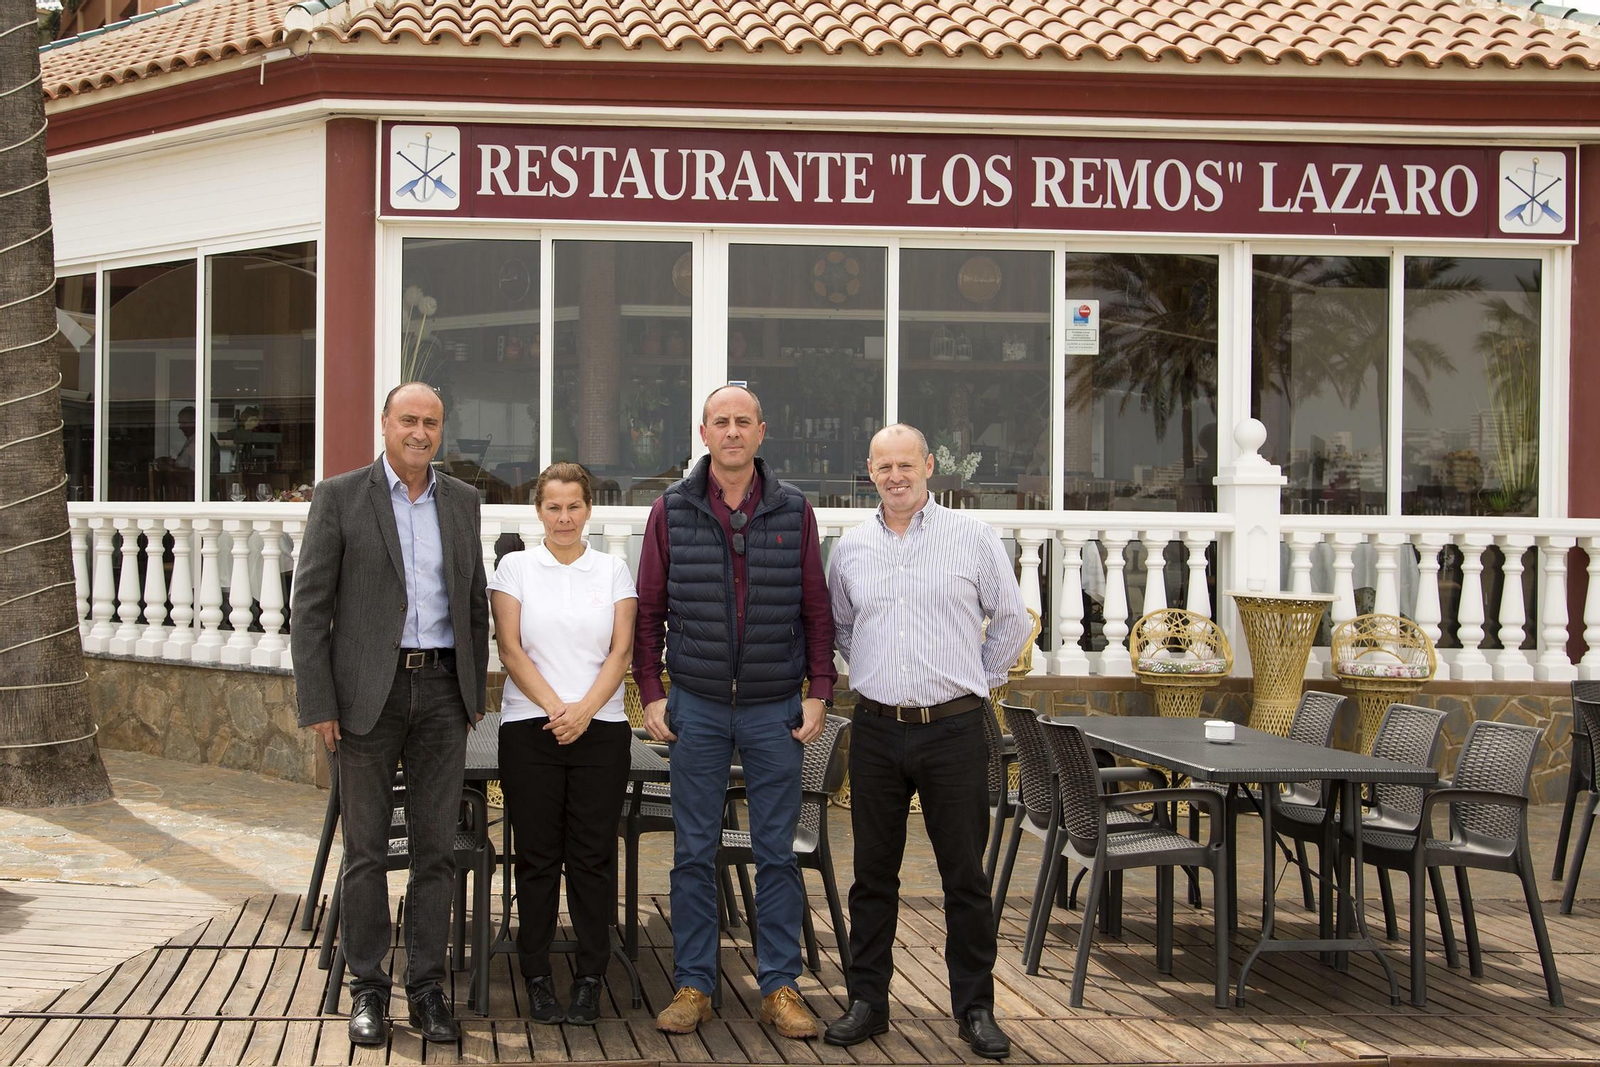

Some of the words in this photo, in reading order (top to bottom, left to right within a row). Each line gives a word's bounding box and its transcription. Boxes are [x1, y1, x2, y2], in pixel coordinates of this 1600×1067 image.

[476, 144, 875, 204] RESTAURANTE
[890, 153, 1013, 207] "LOS
[1031, 156, 1243, 212] REMOS"
[1258, 161, 1478, 217] LAZARO
